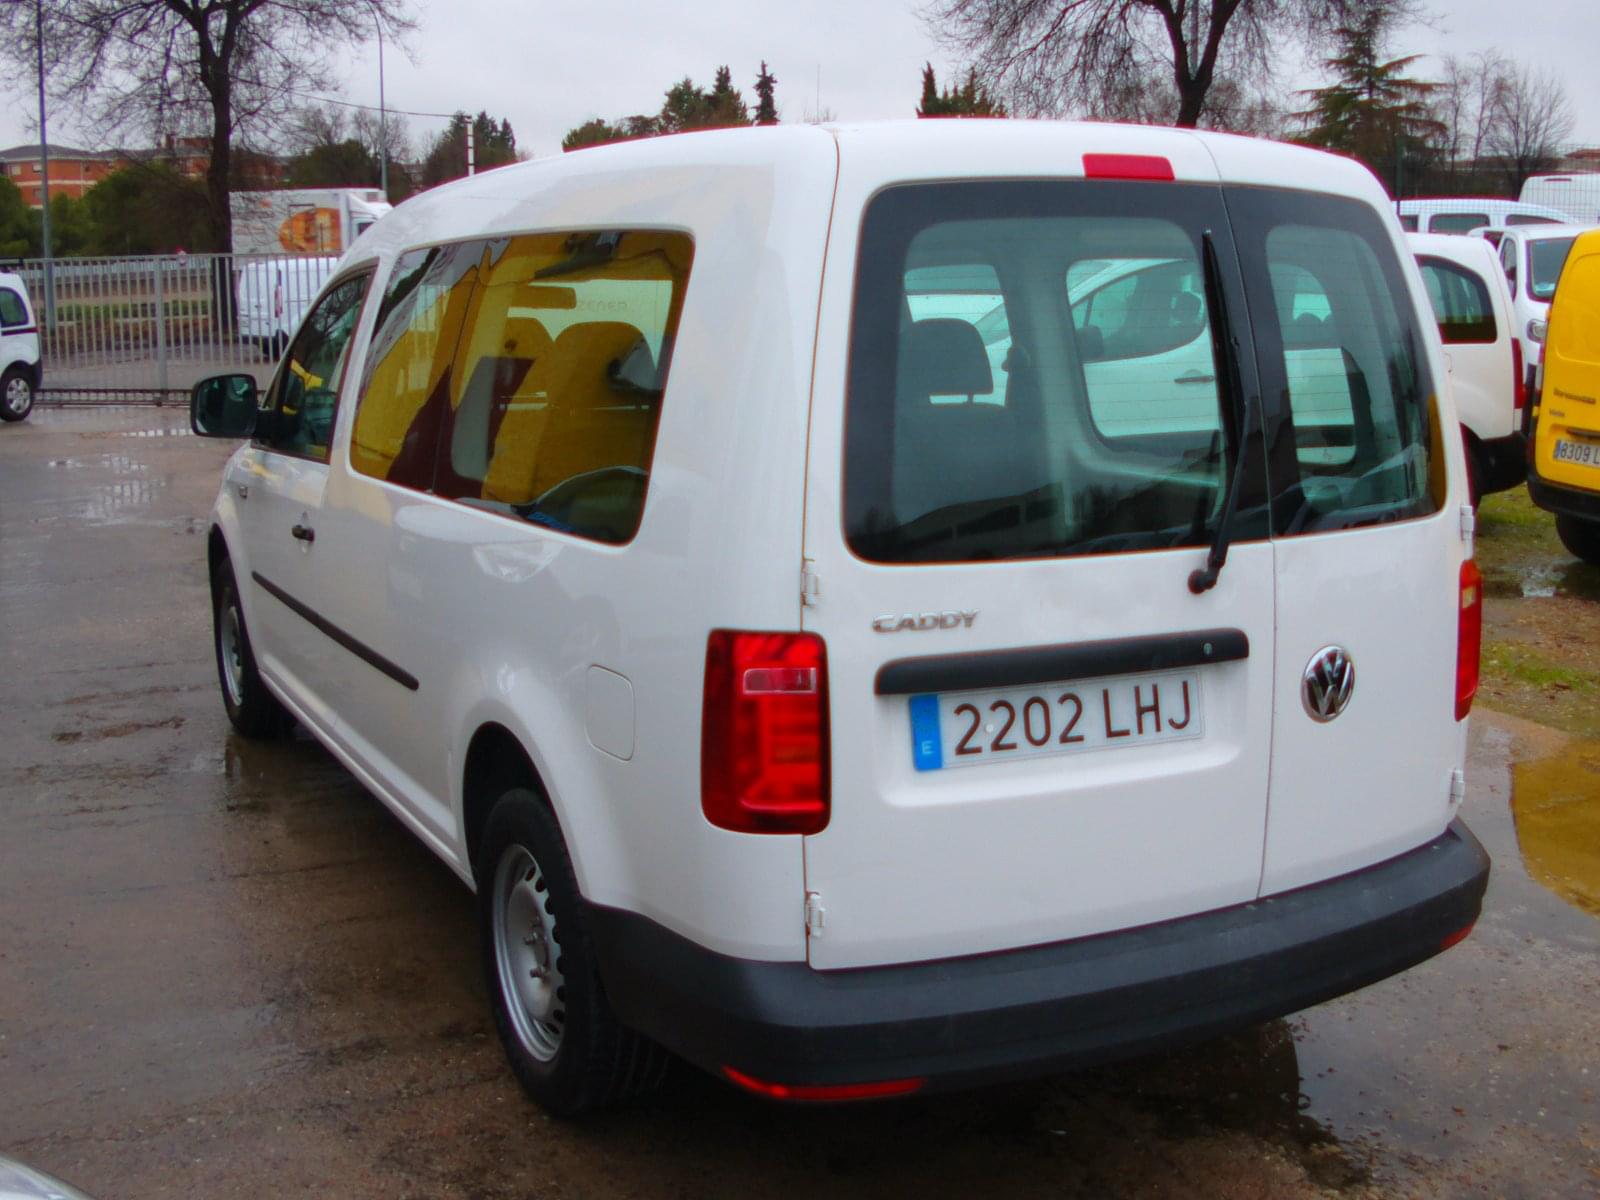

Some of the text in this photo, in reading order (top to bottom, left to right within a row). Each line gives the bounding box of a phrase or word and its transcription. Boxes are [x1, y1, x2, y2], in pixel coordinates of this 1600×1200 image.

[872, 608, 981, 634] CADDY
[953, 680, 1191, 756] 2202 LHJ
[920, 739, 933, 755] E
